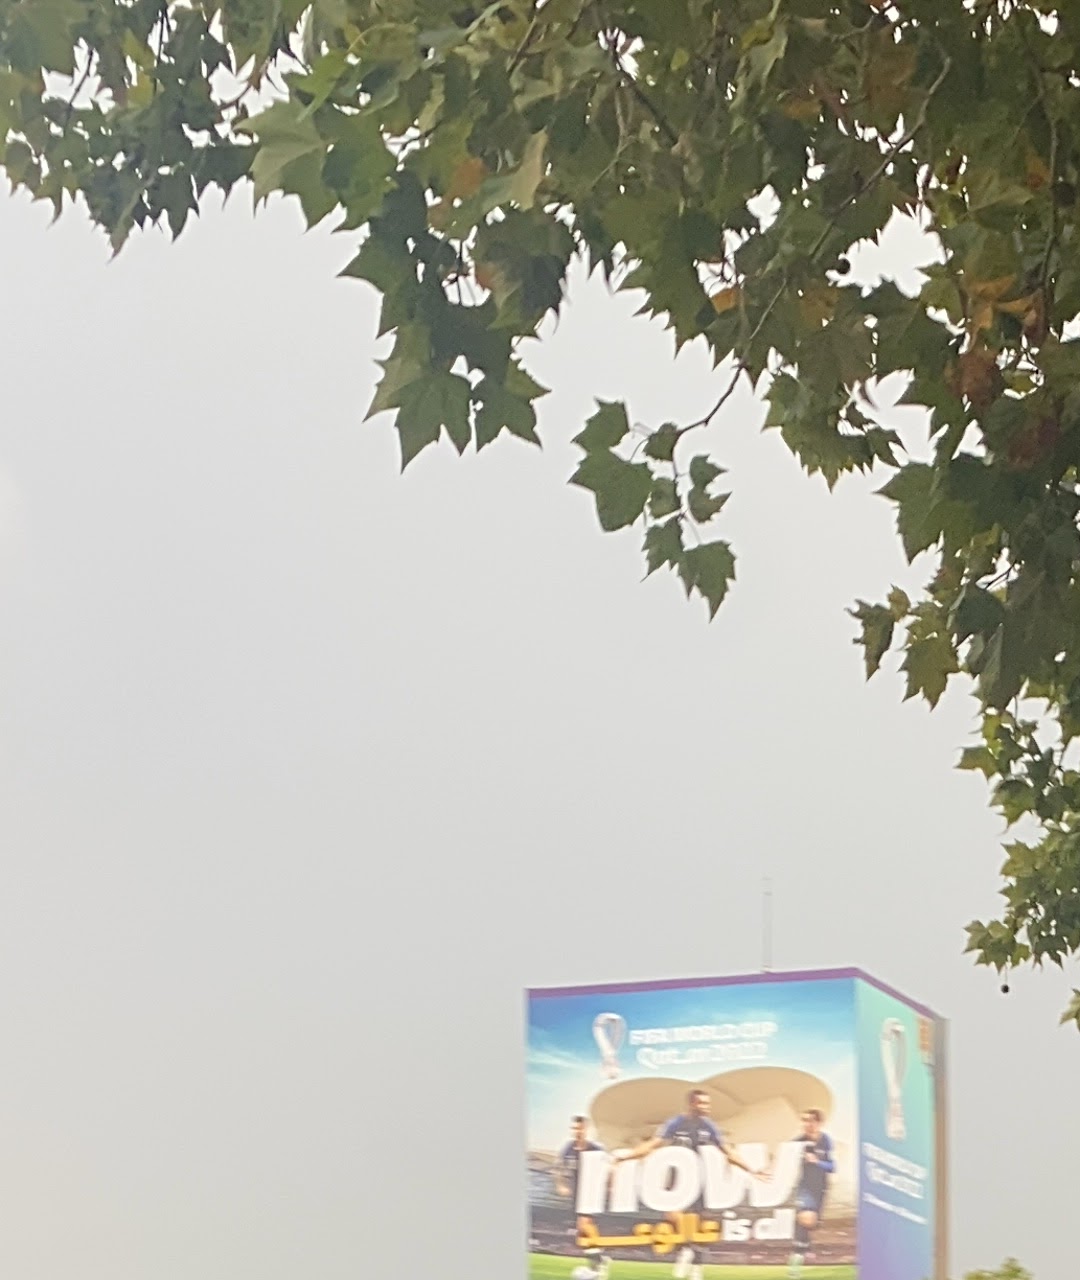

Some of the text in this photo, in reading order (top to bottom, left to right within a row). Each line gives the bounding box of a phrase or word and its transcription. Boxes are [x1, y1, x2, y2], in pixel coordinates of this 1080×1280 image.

[576, 1141, 814, 1213] now
[721, 1208, 796, 1242] is all
